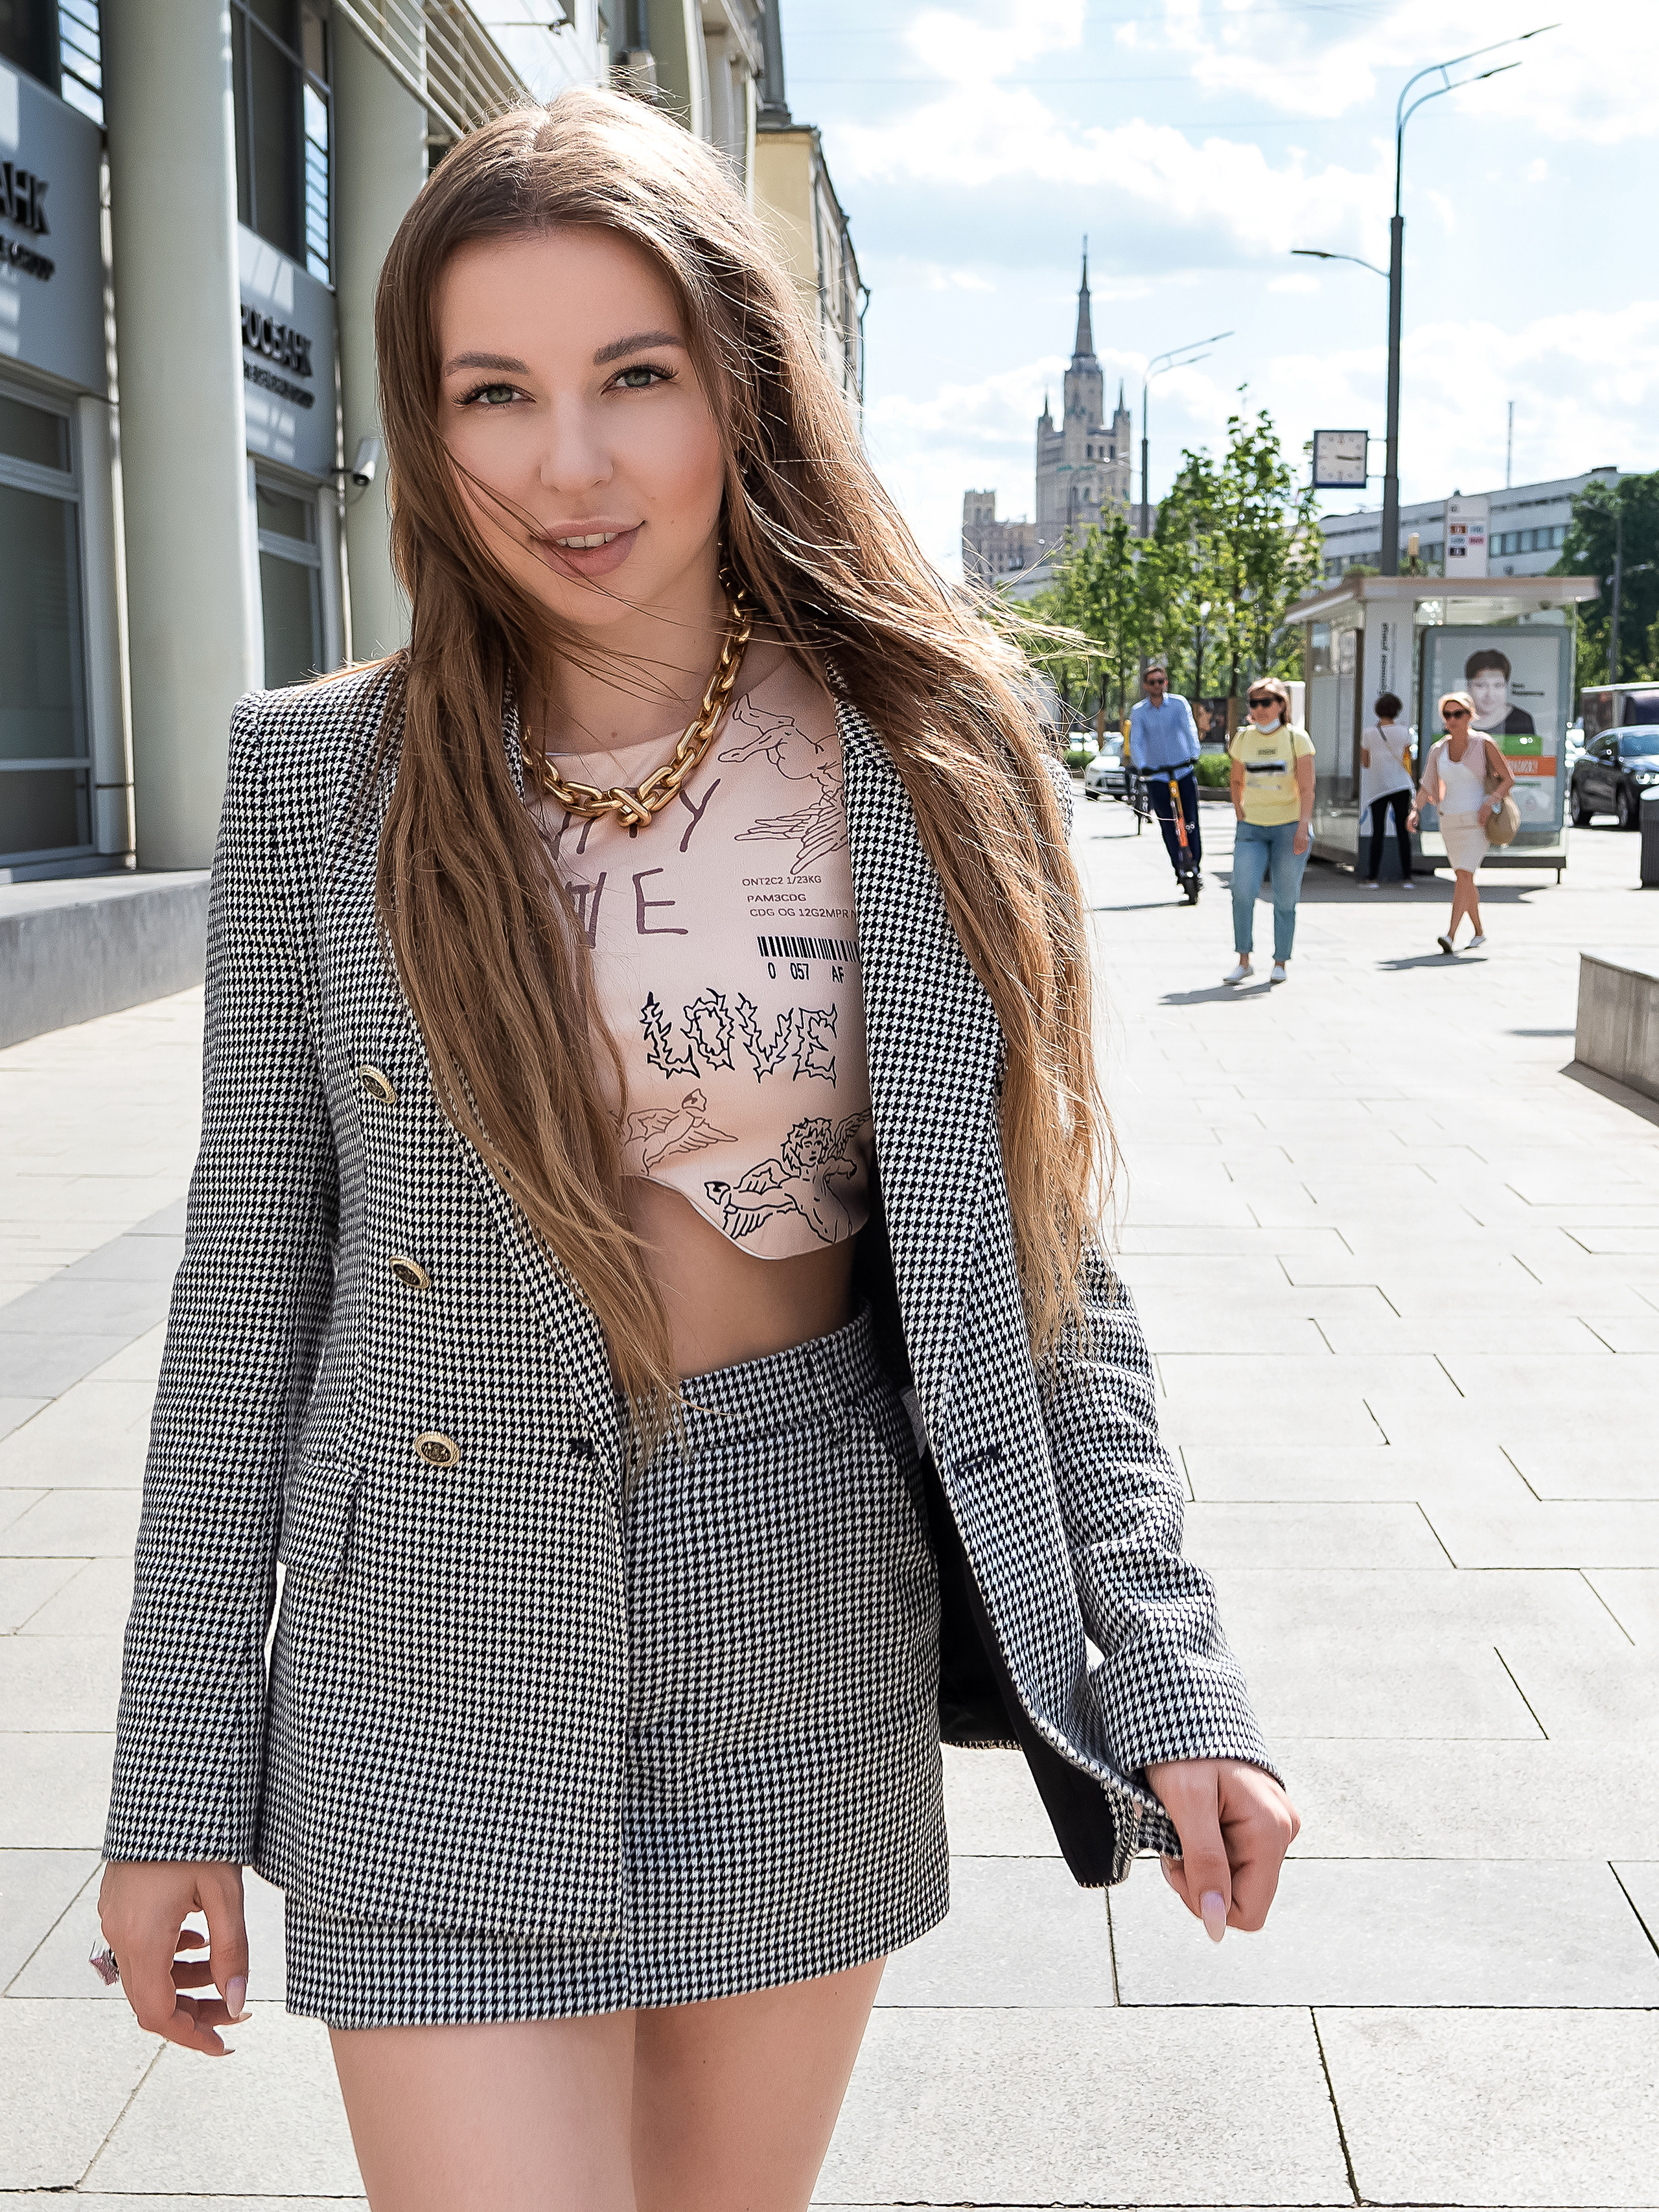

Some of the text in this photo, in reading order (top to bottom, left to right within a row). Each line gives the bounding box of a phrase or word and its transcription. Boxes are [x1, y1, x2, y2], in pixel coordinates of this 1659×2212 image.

[786, 875, 822, 885] 1/23KG
[747, 894, 806, 902] PAM3CDG
[750, 909, 775, 917] CDG
[790, 962, 809, 980] 057
[640, 988, 837, 1089] LOVE
